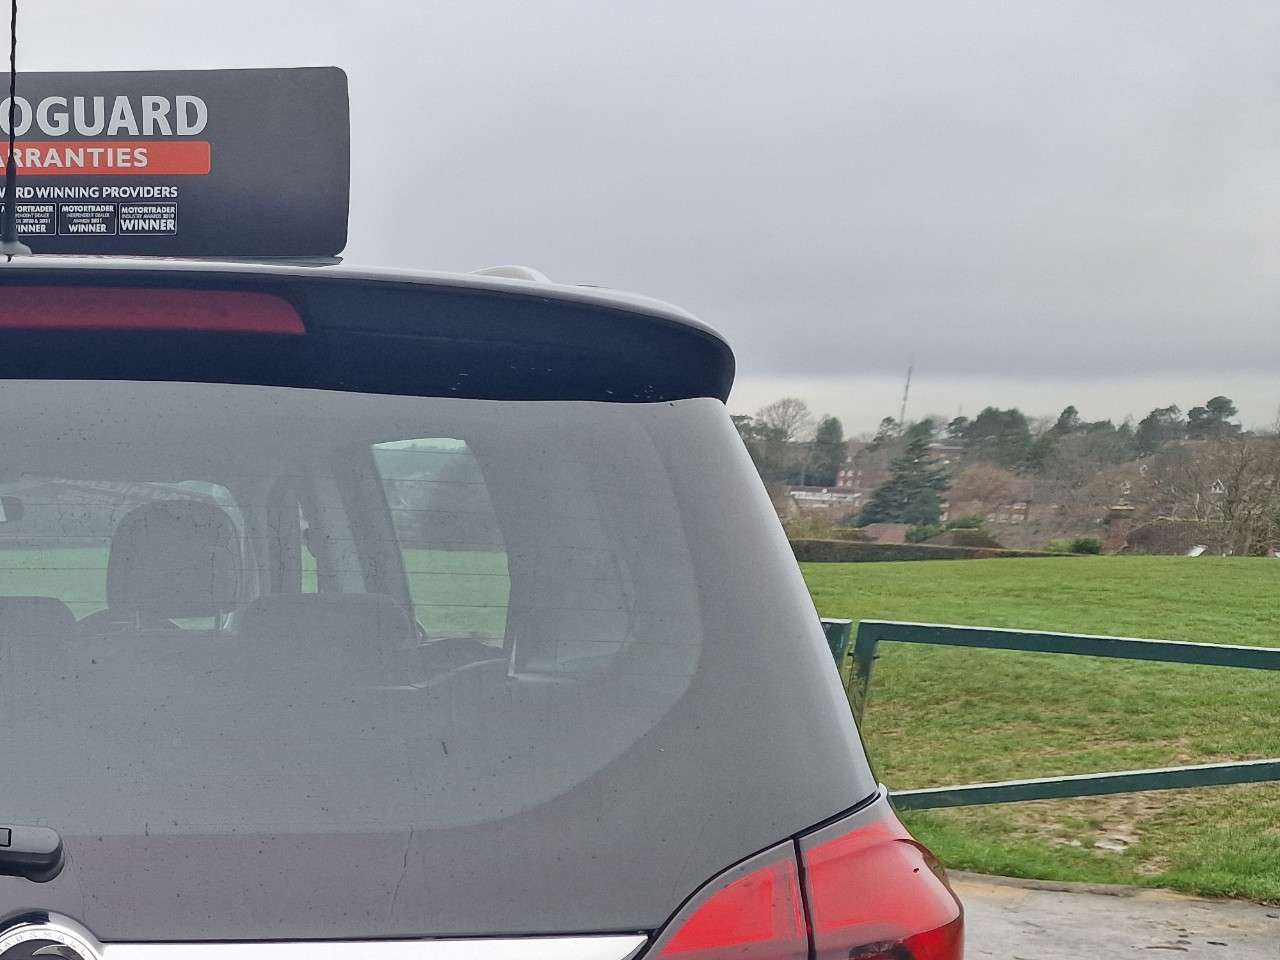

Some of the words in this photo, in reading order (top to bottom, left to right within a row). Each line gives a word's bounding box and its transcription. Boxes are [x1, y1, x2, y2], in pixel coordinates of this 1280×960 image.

[35, 187, 99, 199] WINNING
[102, 186, 178, 198] PROVIDERS
[61, 205, 114, 213] MOTORTRADER
[121, 206, 175, 214] MOTORTRADER
[16, 224, 46, 233] INNER
[68, 224, 107, 232] WINNER
[120, 219, 175, 231] WINNER
